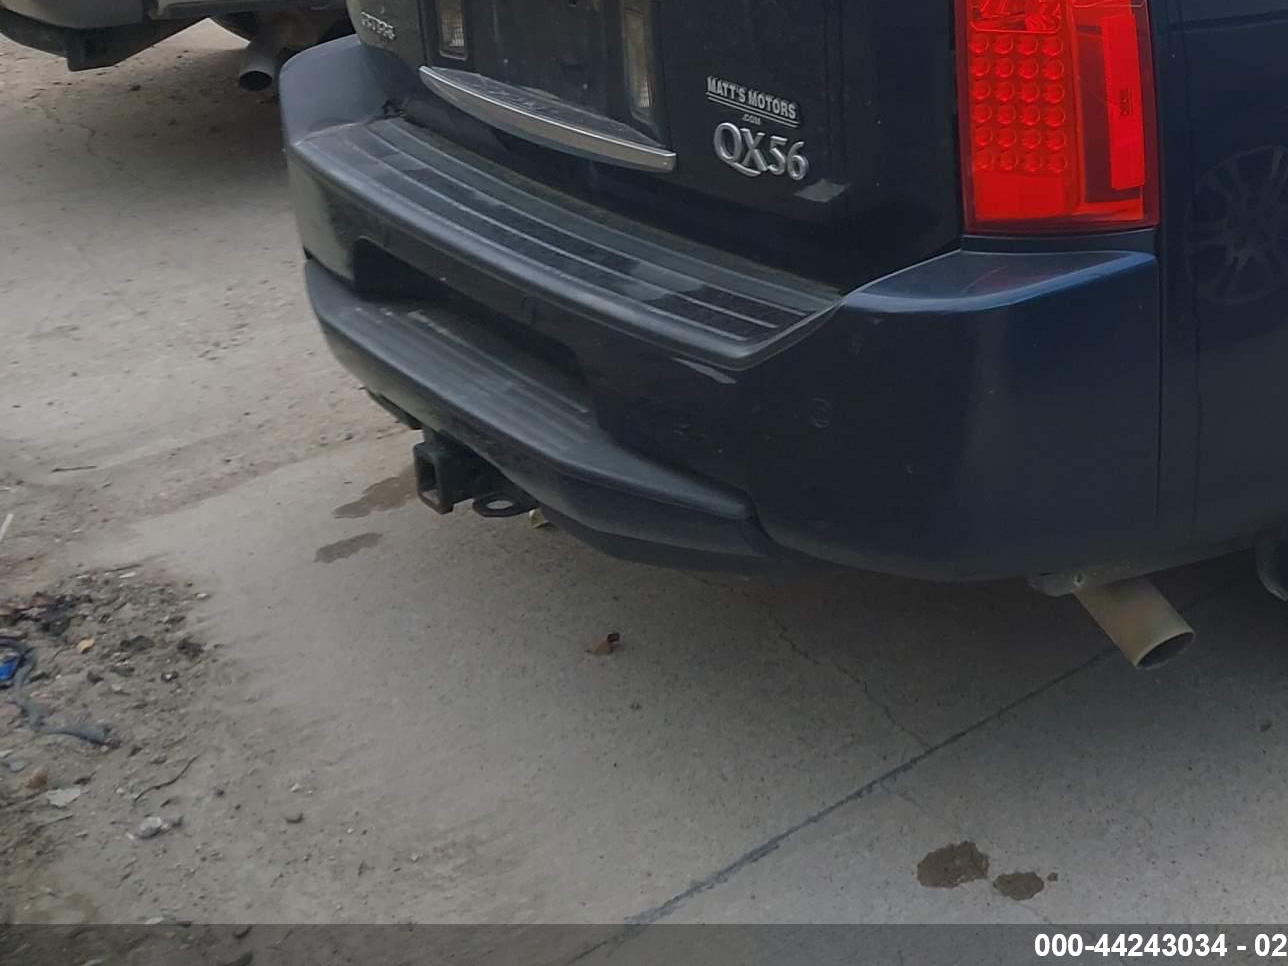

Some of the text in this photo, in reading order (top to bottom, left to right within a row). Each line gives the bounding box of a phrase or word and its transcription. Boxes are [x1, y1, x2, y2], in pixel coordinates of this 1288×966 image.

[706, 76, 797, 119] MATT'S MOTORS
[713, 122, 809, 181] QX56
